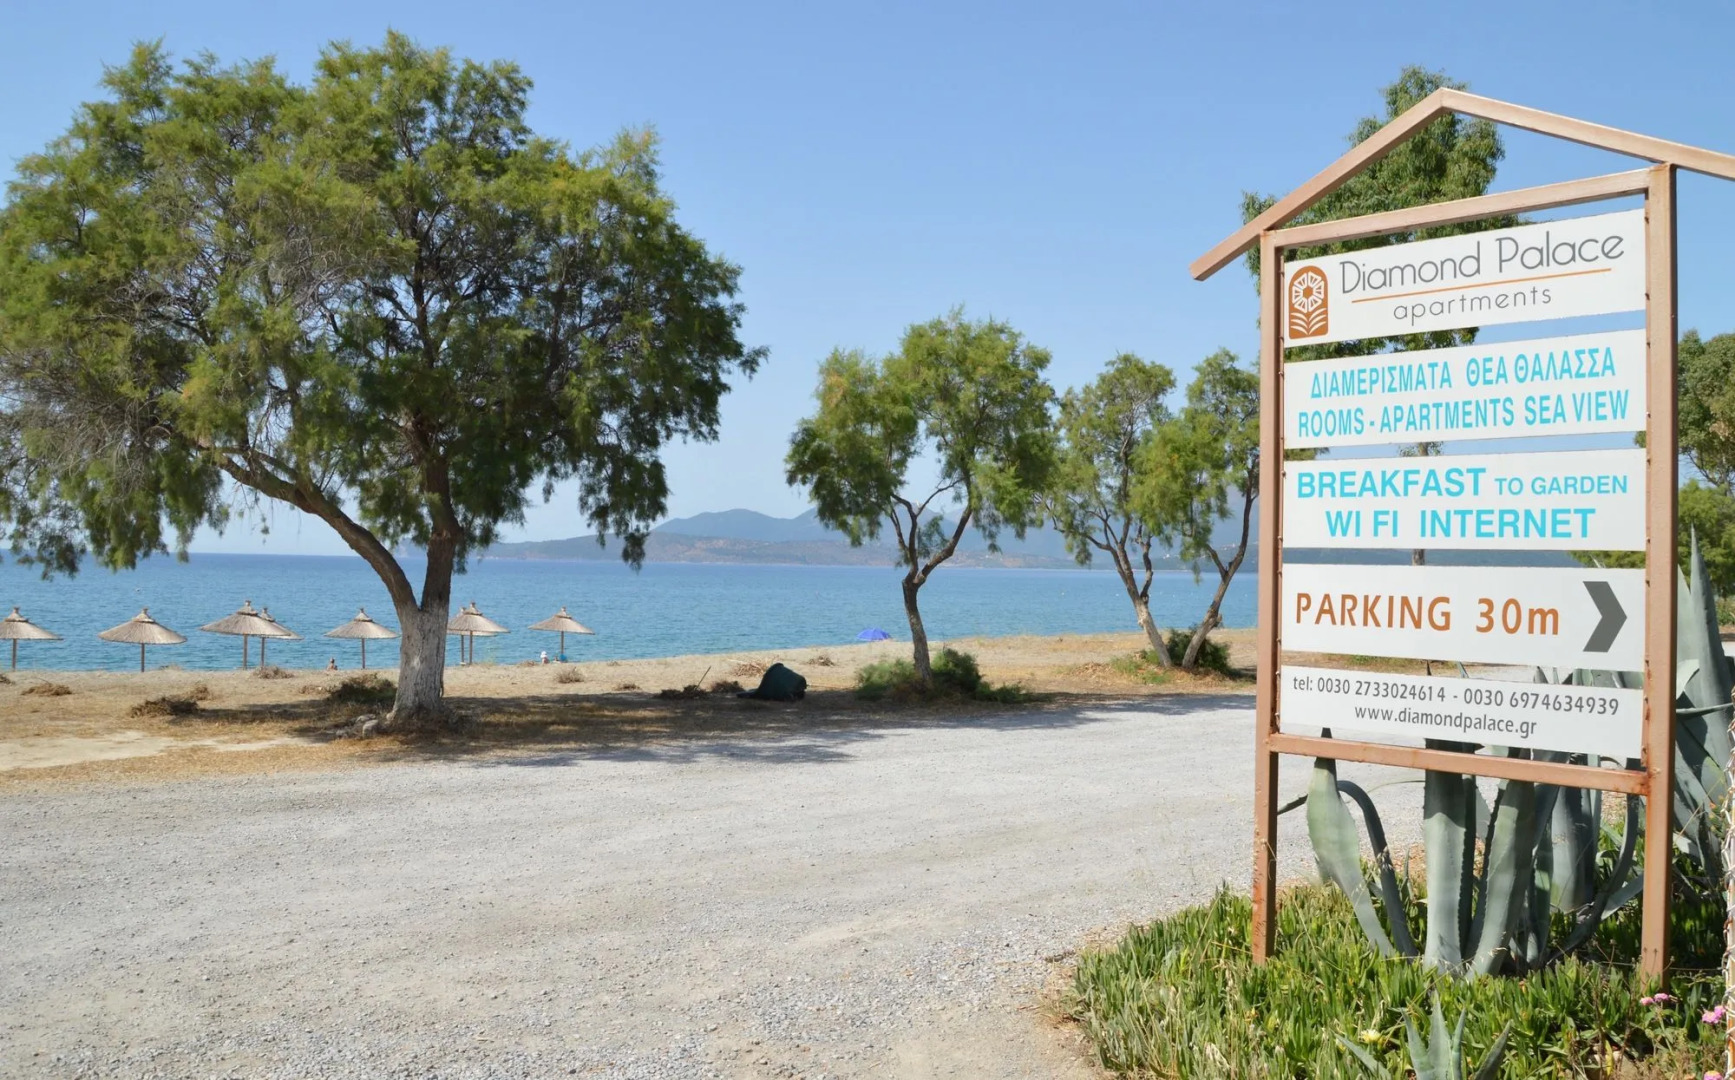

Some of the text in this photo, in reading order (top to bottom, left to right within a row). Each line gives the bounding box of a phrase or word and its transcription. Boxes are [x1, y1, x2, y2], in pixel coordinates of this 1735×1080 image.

[1340, 231, 1624, 294] Diamond Palace
[1393, 286, 1552, 326] apartments
[1311, 347, 1616, 399] ΔΙΑΜΕΡΙΣΜΑΤΑ ΘΕΑ ΘΑΛΑΣΣΑ
[1298, 407, 1365, 438] ROOMS
[1380, 397, 1515, 433] APARTMENTS
[1525, 394, 1567, 426] SEA
[1572, 389, 1629, 422] VIEW
[1297, 467, 1627, 498] BREAKFAST TO GARDEN
[1325, 508, 1596, 538] WI FI INTERNET
[1296, 592, 1559, 635] PARKING 30m
[1293, 676, 1313, 691] tel:
[1317, 678, 1351, 695] 0030
[1355, 680, 1446, 702] 2733024614
[1464, 689, 1504, 707] 0030
[1509, 691, 1619, 715] 6974634939
[1354, 705, 1536, 739] www.diamondpalace.gr
